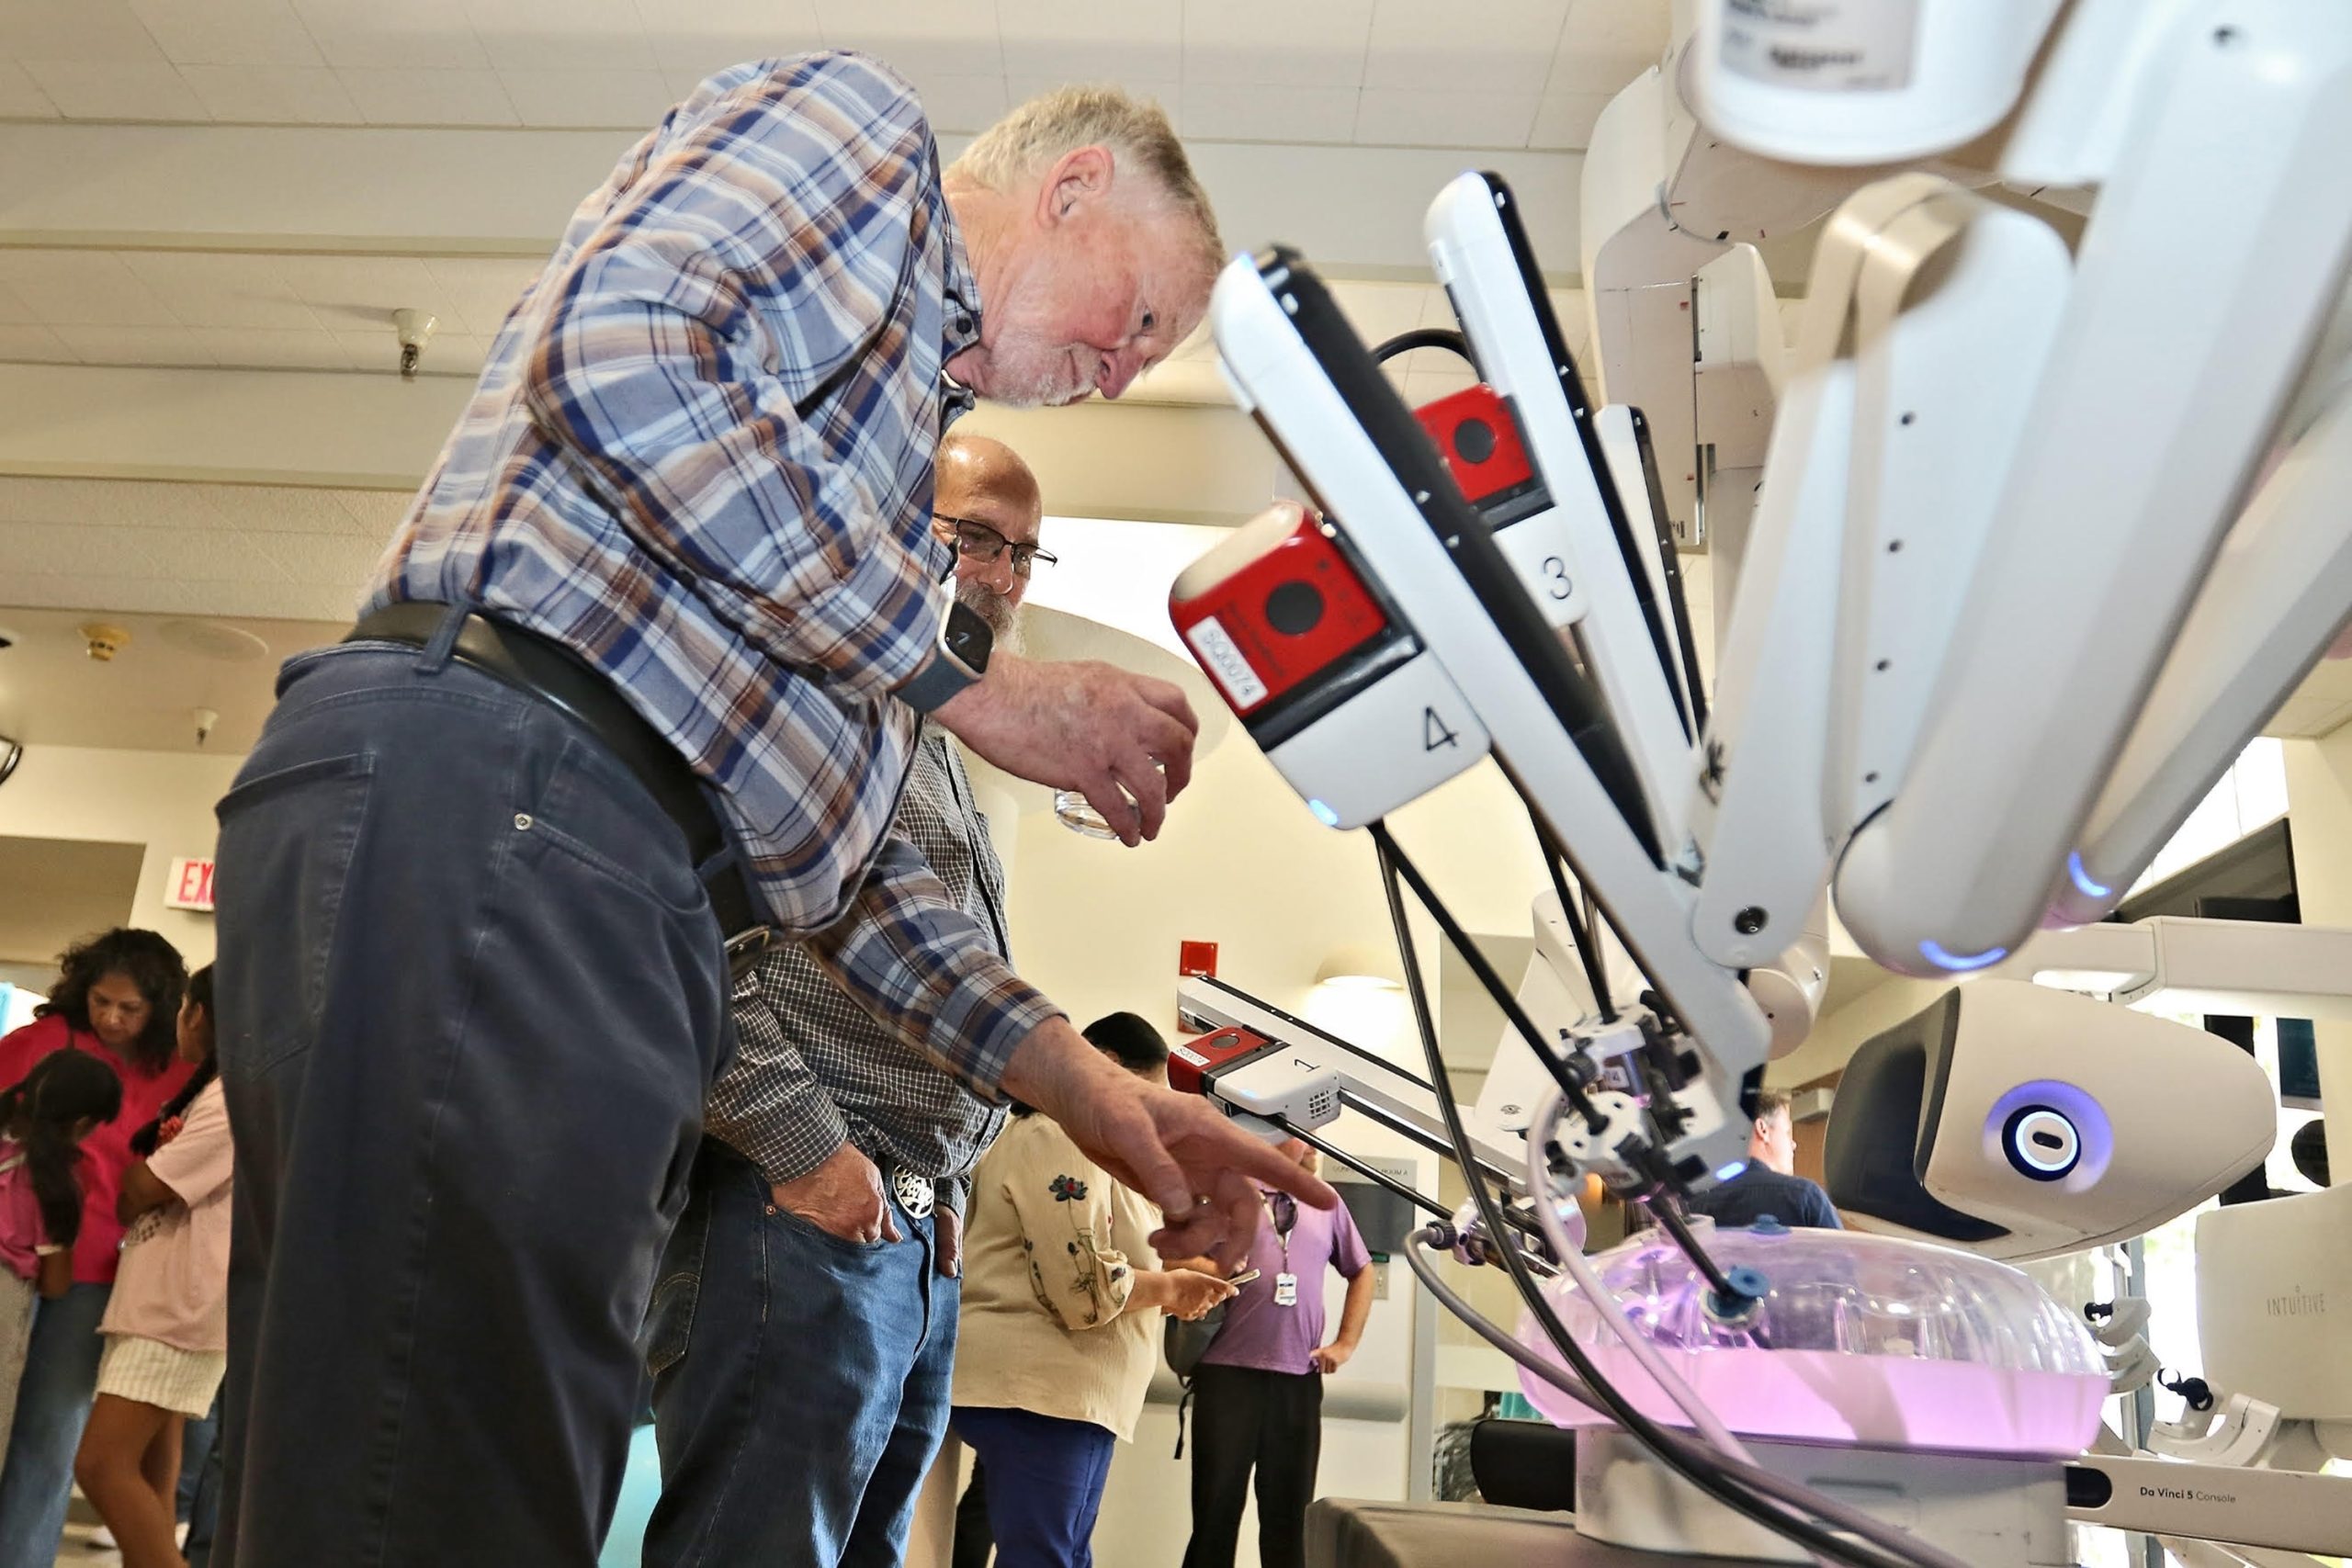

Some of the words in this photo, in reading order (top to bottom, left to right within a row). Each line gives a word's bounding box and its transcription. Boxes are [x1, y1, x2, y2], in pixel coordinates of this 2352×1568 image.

[1543, 556, 1572, 600] 3
[1425, 705, 1459, 751] 4
[1294, 1058, 1321, 1073] 1
[2267, 1285, 2325, 1315] INTUITIVE
[2140, 1486, 2154, 1496] Da
[2157, 1487, 2184, 1499] Vinci
[2186, 1490, 2193, 1499] 5
[2196, 1491, 2236, 1503] Console
